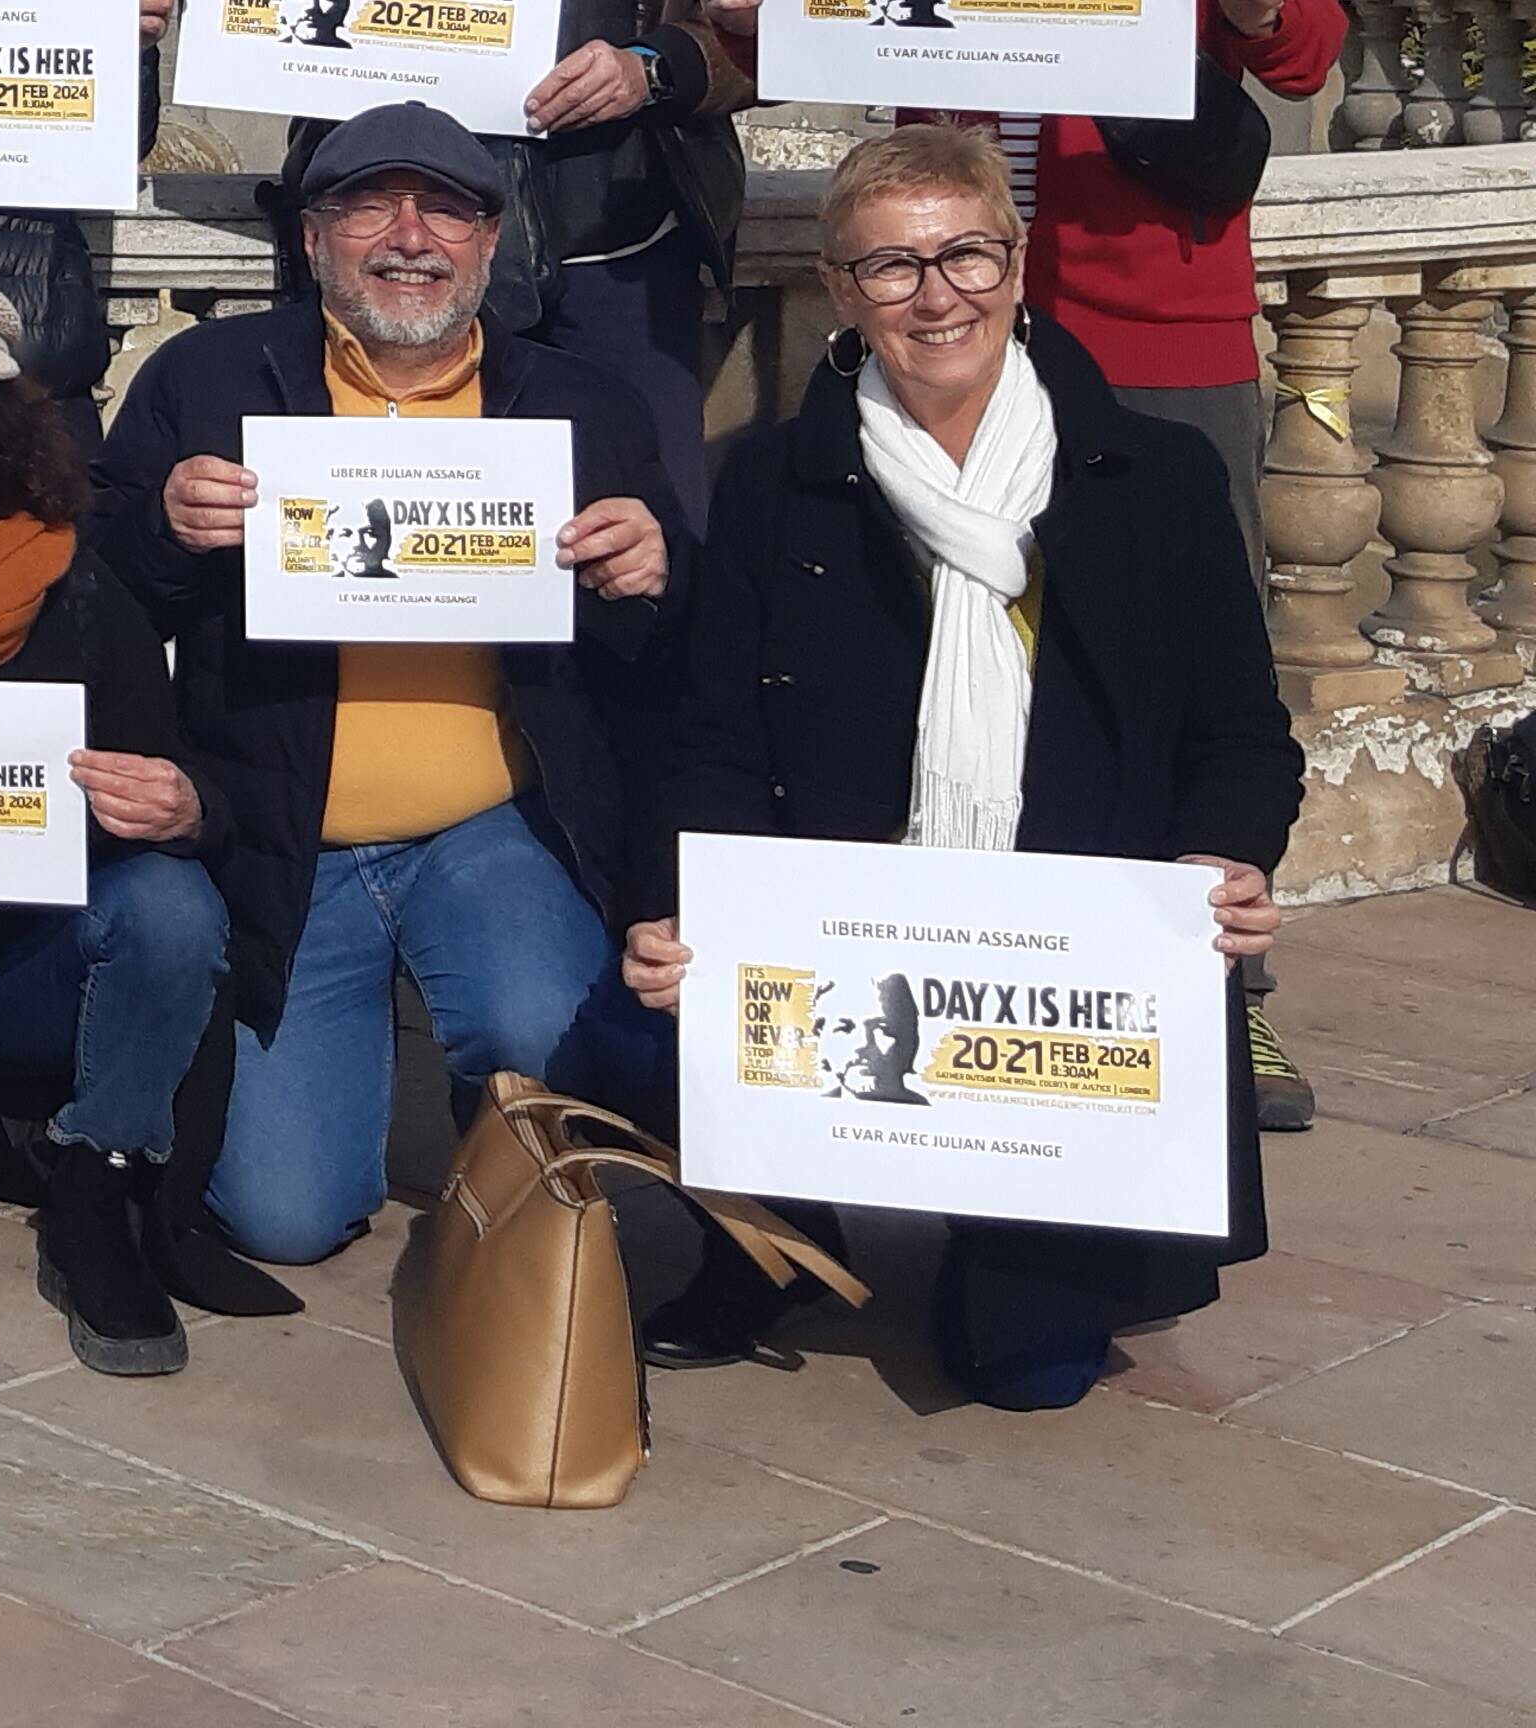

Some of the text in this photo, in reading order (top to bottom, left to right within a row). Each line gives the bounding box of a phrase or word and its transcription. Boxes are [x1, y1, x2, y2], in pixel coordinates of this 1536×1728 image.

[370, 0, 508, 29] 20-21 FEB 2024
[809, 7, 866, 17] EXTRADITION
[9, 47, 30, 75] IS
[36, 48, 94, 75] HERE
[878, 48, 1061, 64] LE VAR AVEC JULIAN ASSANGE
[22, 84, 49, 98] FEB
[53, 85, 89, 99] 2024
[393, 500, 534, 526] DAY X IS HERE
[411, 534, 531, 555] 20-21 FEB 2024
[9, 795, 41, 808] 2024
[823, 920, 1069, 952] LIBERER JULIAN ASSANGE
[744, 980, 792, 1003] NOW
[744, 1001, 771, 1023] OR
[922, 978, 1159, 1034] DAY X IS HERE
[951, 1034, 1154, 1075] 20-21 FEB 2024
[832, 1127, 1062, 1159] LE VAR AVEC JULIAN ASSANGE
